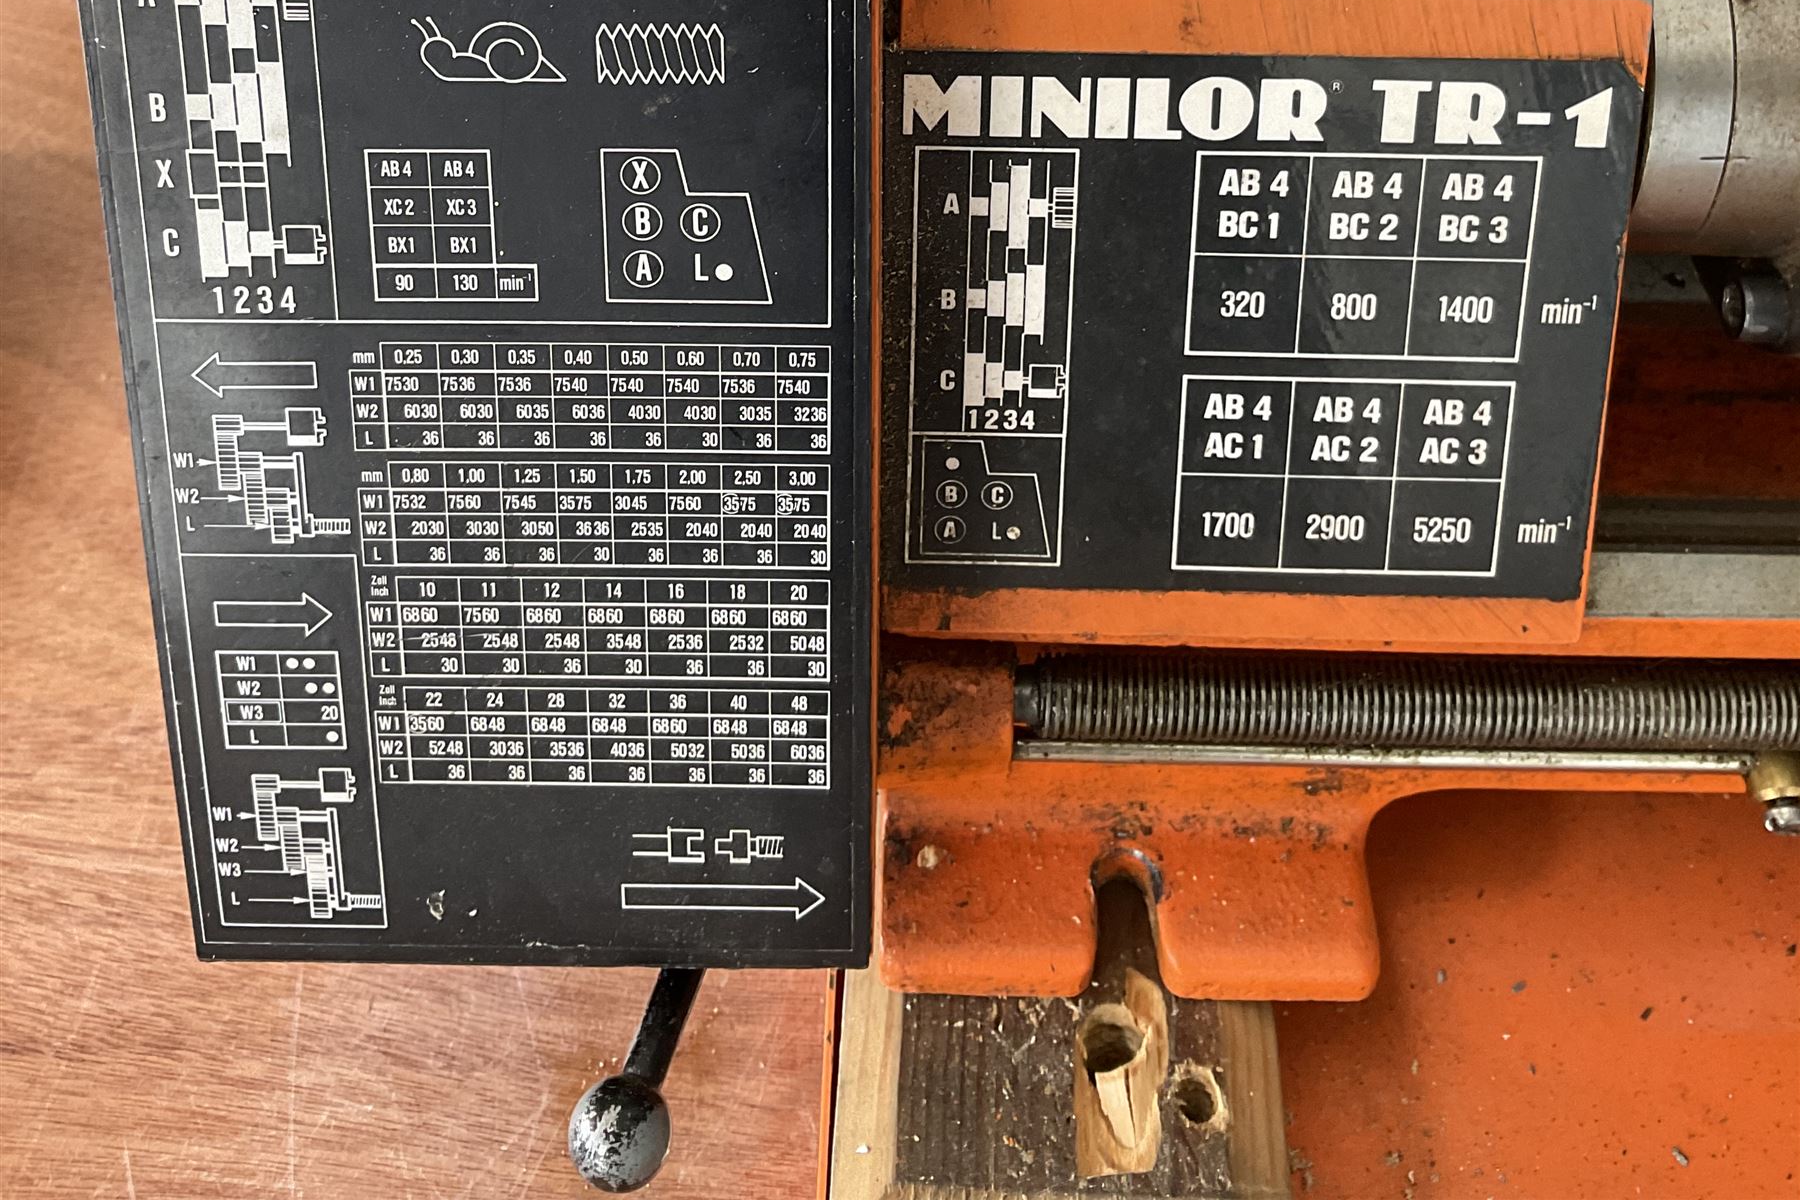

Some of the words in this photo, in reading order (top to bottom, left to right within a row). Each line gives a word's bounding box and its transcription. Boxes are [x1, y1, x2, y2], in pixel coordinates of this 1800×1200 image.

[148, 92, 167, 122] B
[1372, 79, 1614, 148] TR-1
[155, 159, 175, 188] X
[631, 160, 650, 190] X
[1218, 168, 1261, 197] AB
[1269, 170, 1290, 198] 4
[1331, 170, 1374, 199] AB
[1383, 172, 1403, 200] 4
[1441, 172, 1485, 201] AB
[1493, 174, 1514, 202] 4
[943, 192, 960, 215] A
[634, 206, 651, 235] B
[692, 207, 709, 237] C
[1218, 210, 1259, 239] BC
[1267, 212, 1280, 239] 1
[1329, 212, 1370, 241] BC
[1378, 213, 1399, 241] 2
[1438, 214, 1480, 243] BC
[1488, 215, 1509, 244] 3
[162, 228, 180, 257] C
[635, 253, 653, 282] A
[694, 253, 709, 281] L
[394, 274, 414, 291] 90
[452, 274, 478, 291] 130
[937, 288, 957, 310] B
[1220, 290, 1266, 318] 320
[1330, 292, 1377, 321] 800
[1439, 295, 1494, 324] 1400
[352, 352, 376, 364] mm
[393, 348, 423, 365] 0,25
[450, 348, 480, 365] 0,30
[507, 349, 536, 366] 0,35
[564, 349, 593, 366] 0,40
[620, 350, 649, 366] 0,50
[676, 350, 705, 367] 0,60
[732, 351, 761, 368] 0,70
[788, 352, 816, 368] 0,75
[940, 369, 956, 391] C
[1203, 392, 1245, 420] AB
[1252, 395, 1272, 421] 4
[1312, 396, 1354, 423] AB
[1362, 397, 1382, 424] 4
[1422, 398, 1465, 426] AB
[1472, 400, 1492, 426] 4
[1203, 432, 1244, 459] AC
[1252, 433, 1264, 460] 1
[1310, 434, 1351, 462] AC
[1359, 436, 1379, 463] 2
[1419, 437, 1460, 465] AC
[1467, 438, 1488, 465] 3
[172, 452, 194, 469] W1
[361, 471, 384, 483] mm
[401, 467, 430, 484] 0,80
[458, 467, 486, 484] 1,00
[514, 468, 541, 484] 1,25
[569, 468, 596, 485] 1,50
[624, 468, 652, 485] 1,75
[679, 469, 707, 485] 2,00
[734, 470, 762, 486] 2,50
[788, 470, 816, 487] 3,00
[174, 487, 200, 504] W2
[945, 485, 958, 503] B
[991, 486, 1005, 504] C
[185, 515, 196, 532] L
[943, 520, 956, 538] A
[992, 521, 1002, 540] L
[1202, 511, 1255, 539] 1700
[1305, 513, 1365, 541] 2900
[1413, 516, 1472, 544] 5250
[419, 581, 436, 598] 10
[481, 581, 496, 598] 11
[543, 582, 561, 598] 12
[606, 582, 623, 599] 14
[668, 583, 685, 600] 16
[729, 583, 746, 600] 18
[790, 584, 808, 601] 20
[235, 655, 256, 672] W1
[236, 680, 262, 696] W2
[239, 704, 264, 720] W3
[320, 705, 339, 721] 20
[425, 691, 443, 707] 22
[486, 692, 504, 708] 24
[547, 692, 565, 709] 28
[608, 693, 626, 709] 32
[669, 693, 687, 710] 36
[729, 694, 748, 711] 40
[790, 695, 808, 712] 48
[249, 728, 260, 744] L
[212, 806, 233, 822] W1
